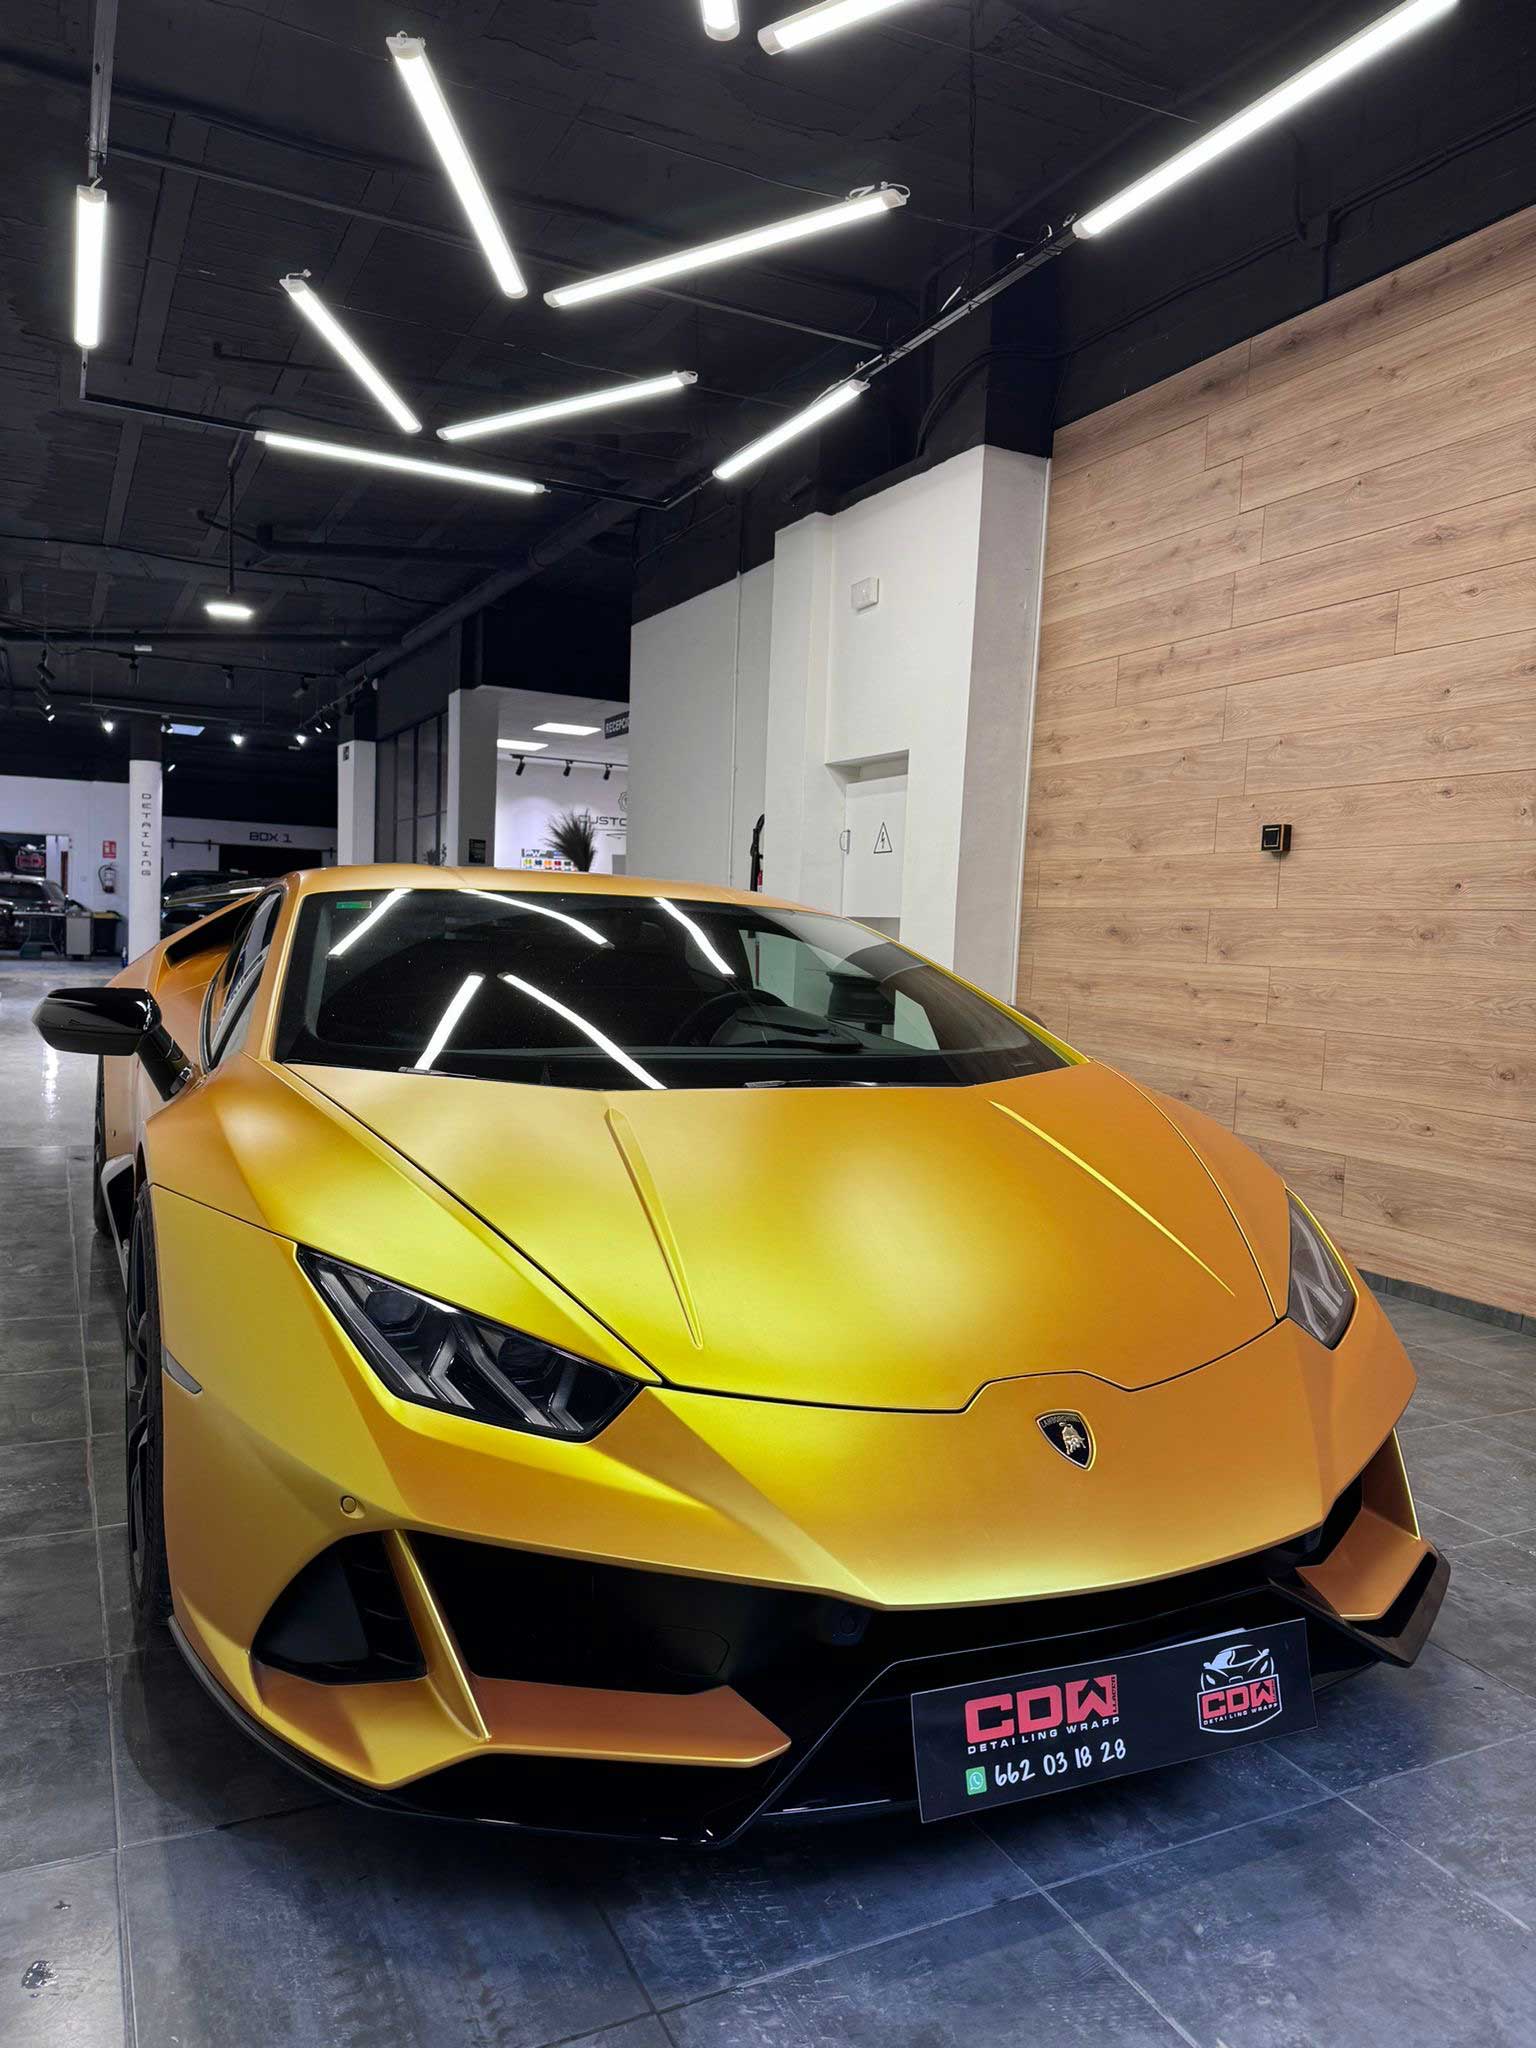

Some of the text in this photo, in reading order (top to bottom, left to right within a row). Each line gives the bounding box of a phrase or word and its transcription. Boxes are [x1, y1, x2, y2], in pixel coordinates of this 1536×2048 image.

[141, 792, 152, 876] DETAILING
[249, 831, 293, 844] BOX 1
[965, 1674, 1119, 1744] CDW
[1201, 1679, 1278, 1720] CDW
[1203, 1710, 1248, 1726] DETAILING
[967, 1716, 1120, 1755] DETAILING WRAPP
[994, 1738, 1127, 1787] 662 03 18 28
